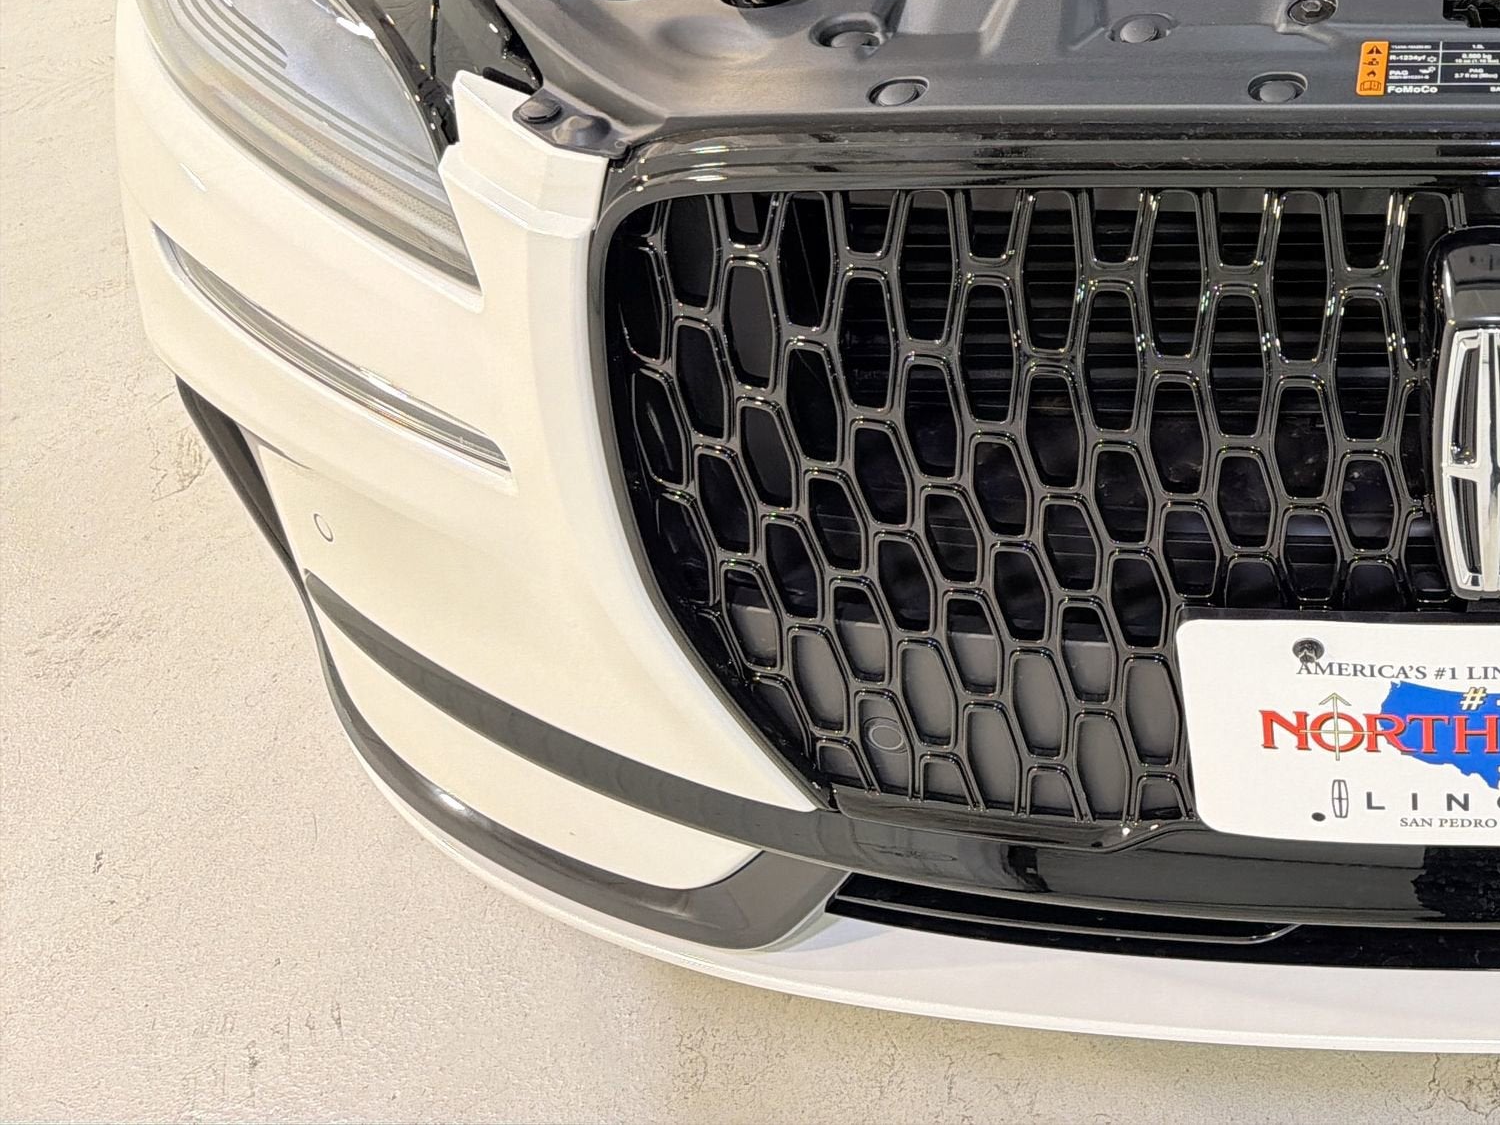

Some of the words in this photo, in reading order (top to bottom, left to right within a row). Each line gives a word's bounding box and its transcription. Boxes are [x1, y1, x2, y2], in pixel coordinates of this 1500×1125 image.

[1387, 85, 1439, 94] FoMoCo
[1296, 661, 1428, 680] AMERICA'S
[1434, 666, 1459, 680] #1
[1400, 817, 1433, 829] SAN
[1439, 817, 1498, 829] PEDRO
